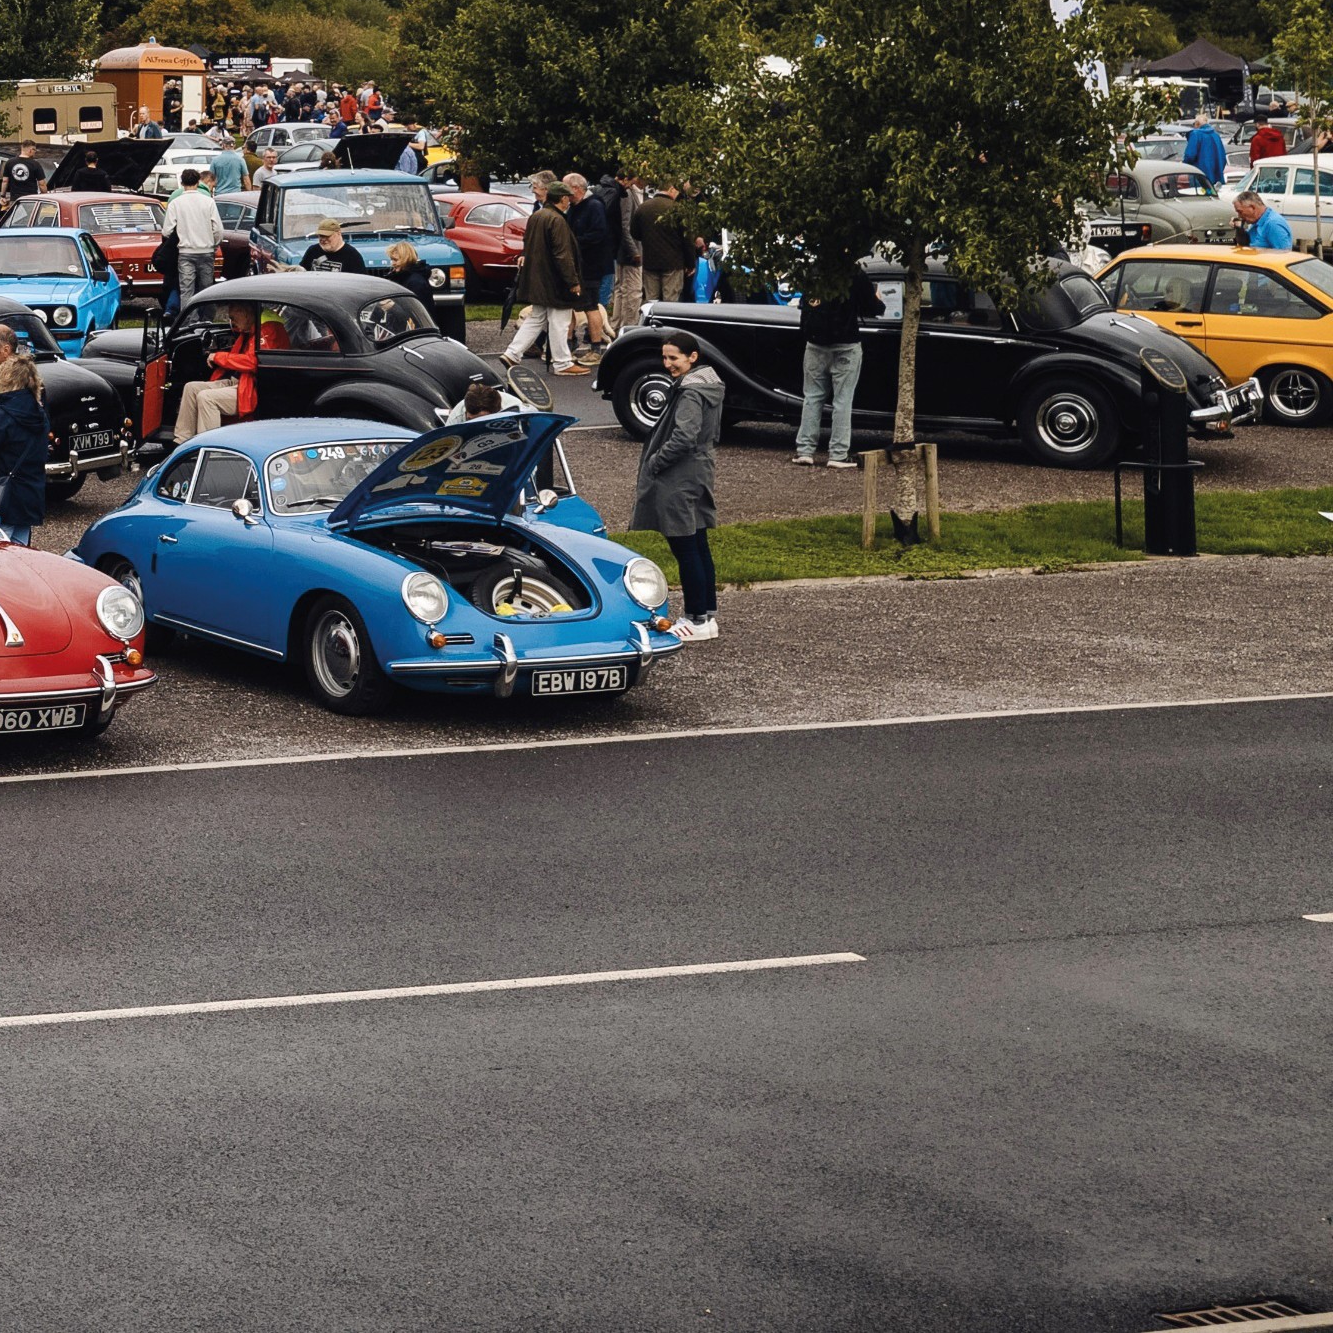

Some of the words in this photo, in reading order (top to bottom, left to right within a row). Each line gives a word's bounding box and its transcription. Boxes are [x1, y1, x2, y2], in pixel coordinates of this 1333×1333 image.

[174, 57, 198, 67] Coffee
[73, 435, 92, 450] XVM
[92, 432, 110, 447] 799
[317, 446, 346, 460] 249
[538, 672, 576, 693] EBW
[580, 669, 621, 690] 197B
[36, 707, 77, 728] XWB
